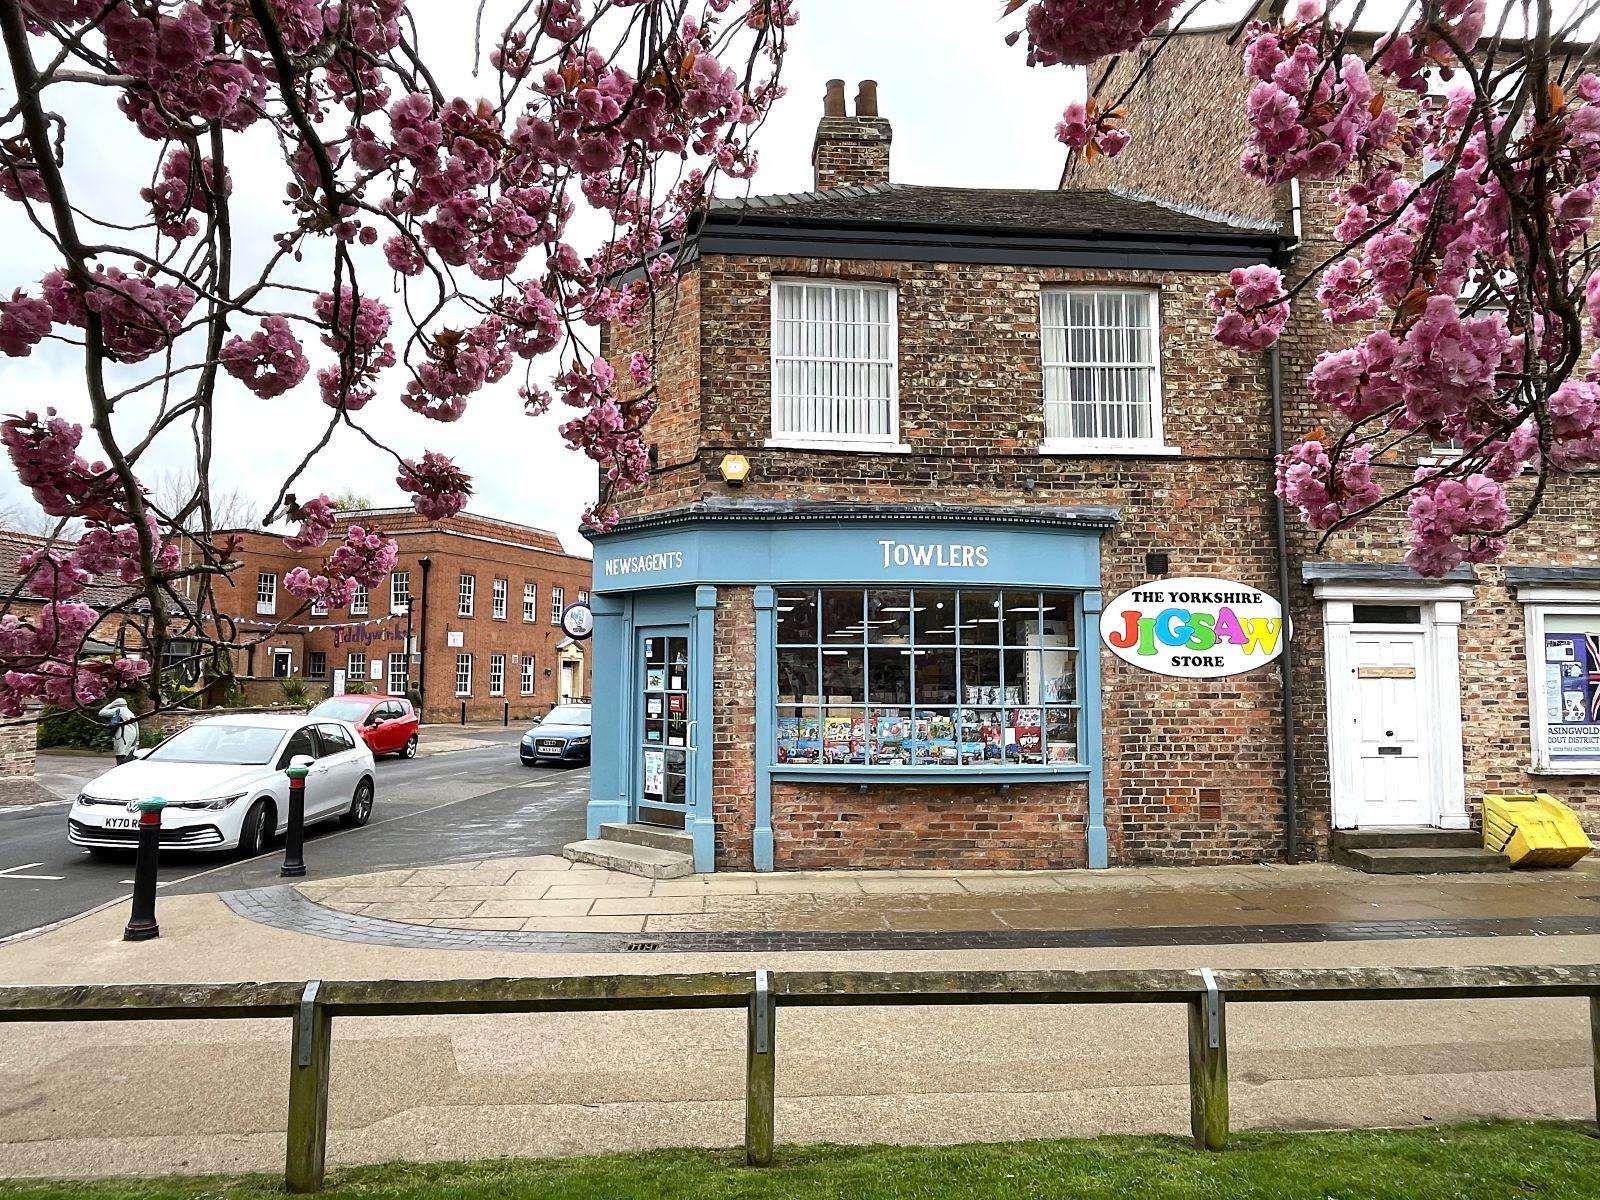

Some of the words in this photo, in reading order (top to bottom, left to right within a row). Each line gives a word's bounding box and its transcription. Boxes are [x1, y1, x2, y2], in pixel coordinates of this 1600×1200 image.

[878, 539, 989, 569] TOWLERS
[604, 550, 684, 577] NEWSAGENTS
[1132, 591, 1165, 603] THE
[1168, 591, 1263, 604] YORKSHIRE
[1108, 606, 1283, 656] JIGSAW
[1171, 655, 1225, 667] STORE
[1019, 736, 1040, 747] WOW
[105, 817, 130, 828] KY70
